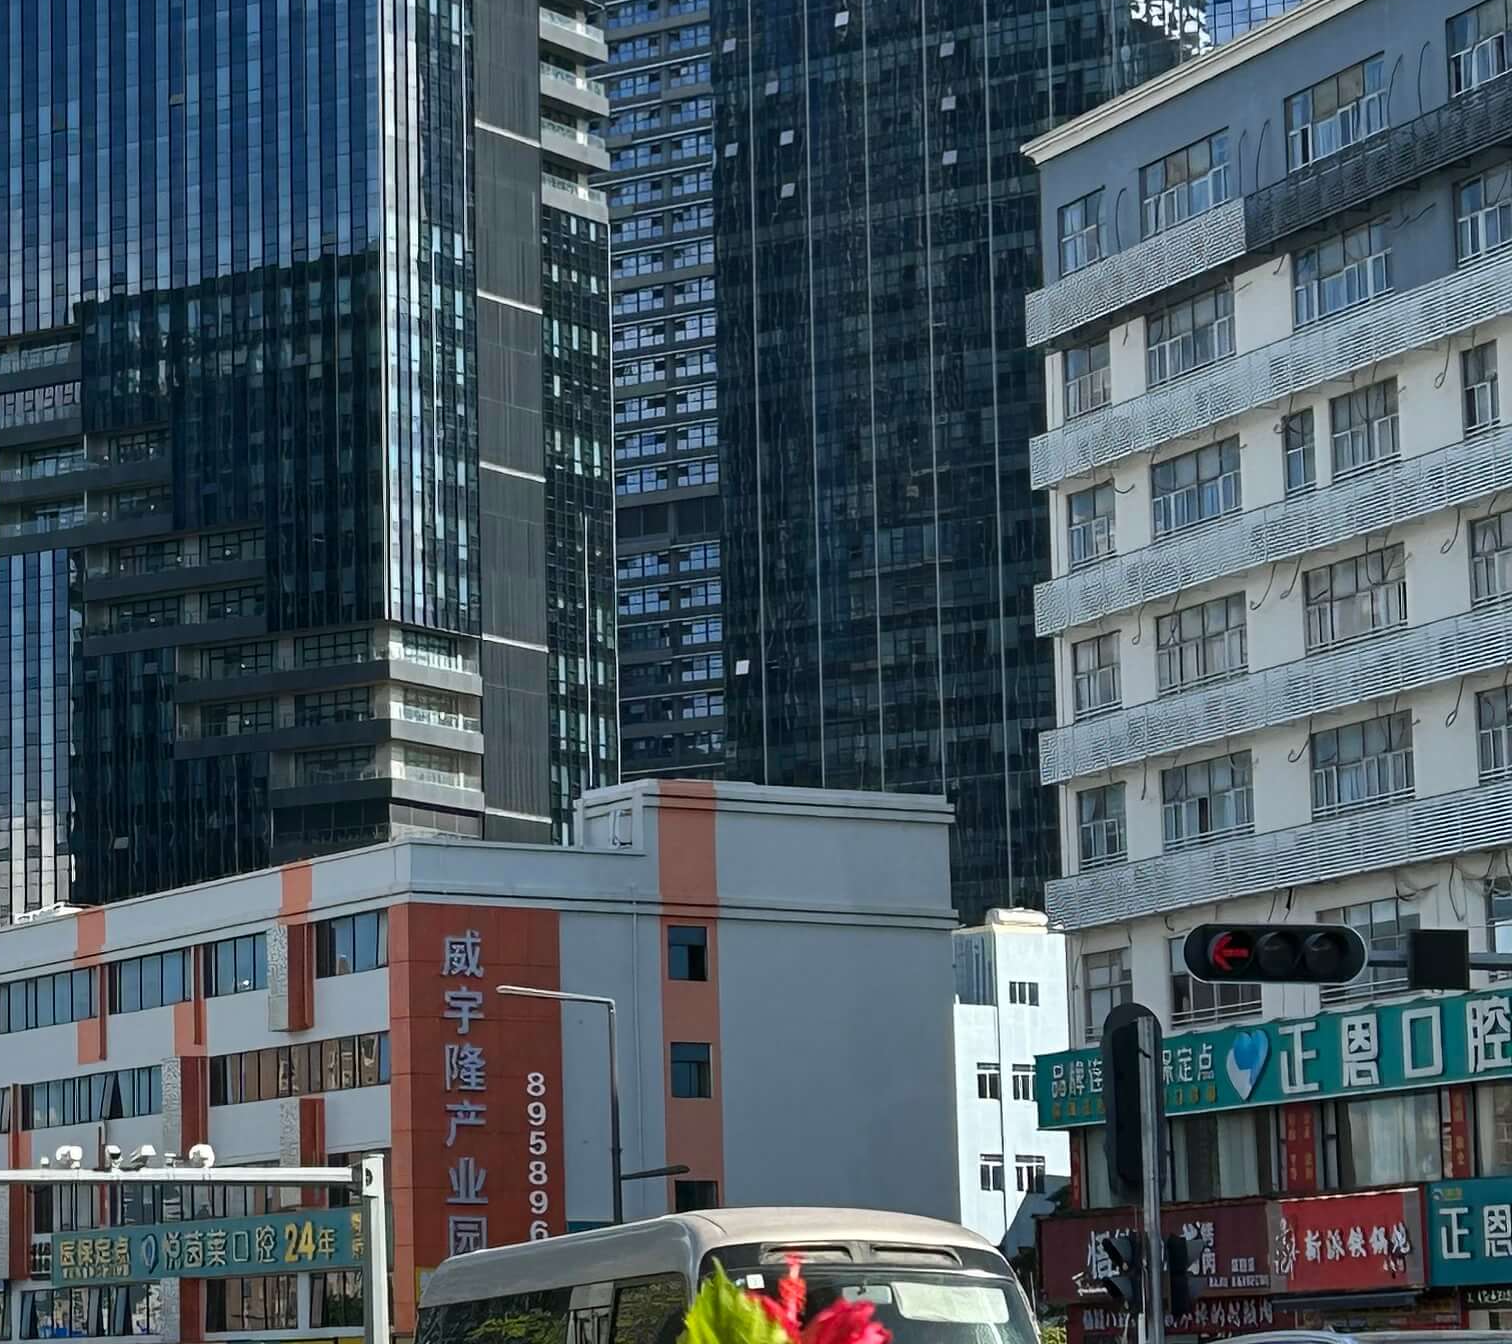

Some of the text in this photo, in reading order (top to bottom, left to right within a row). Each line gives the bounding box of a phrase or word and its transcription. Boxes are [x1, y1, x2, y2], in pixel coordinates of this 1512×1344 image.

[441, 928, 489, 1256] 威宇隆产业园
[1278, 995, 1512, 1095] 正恩口腔
